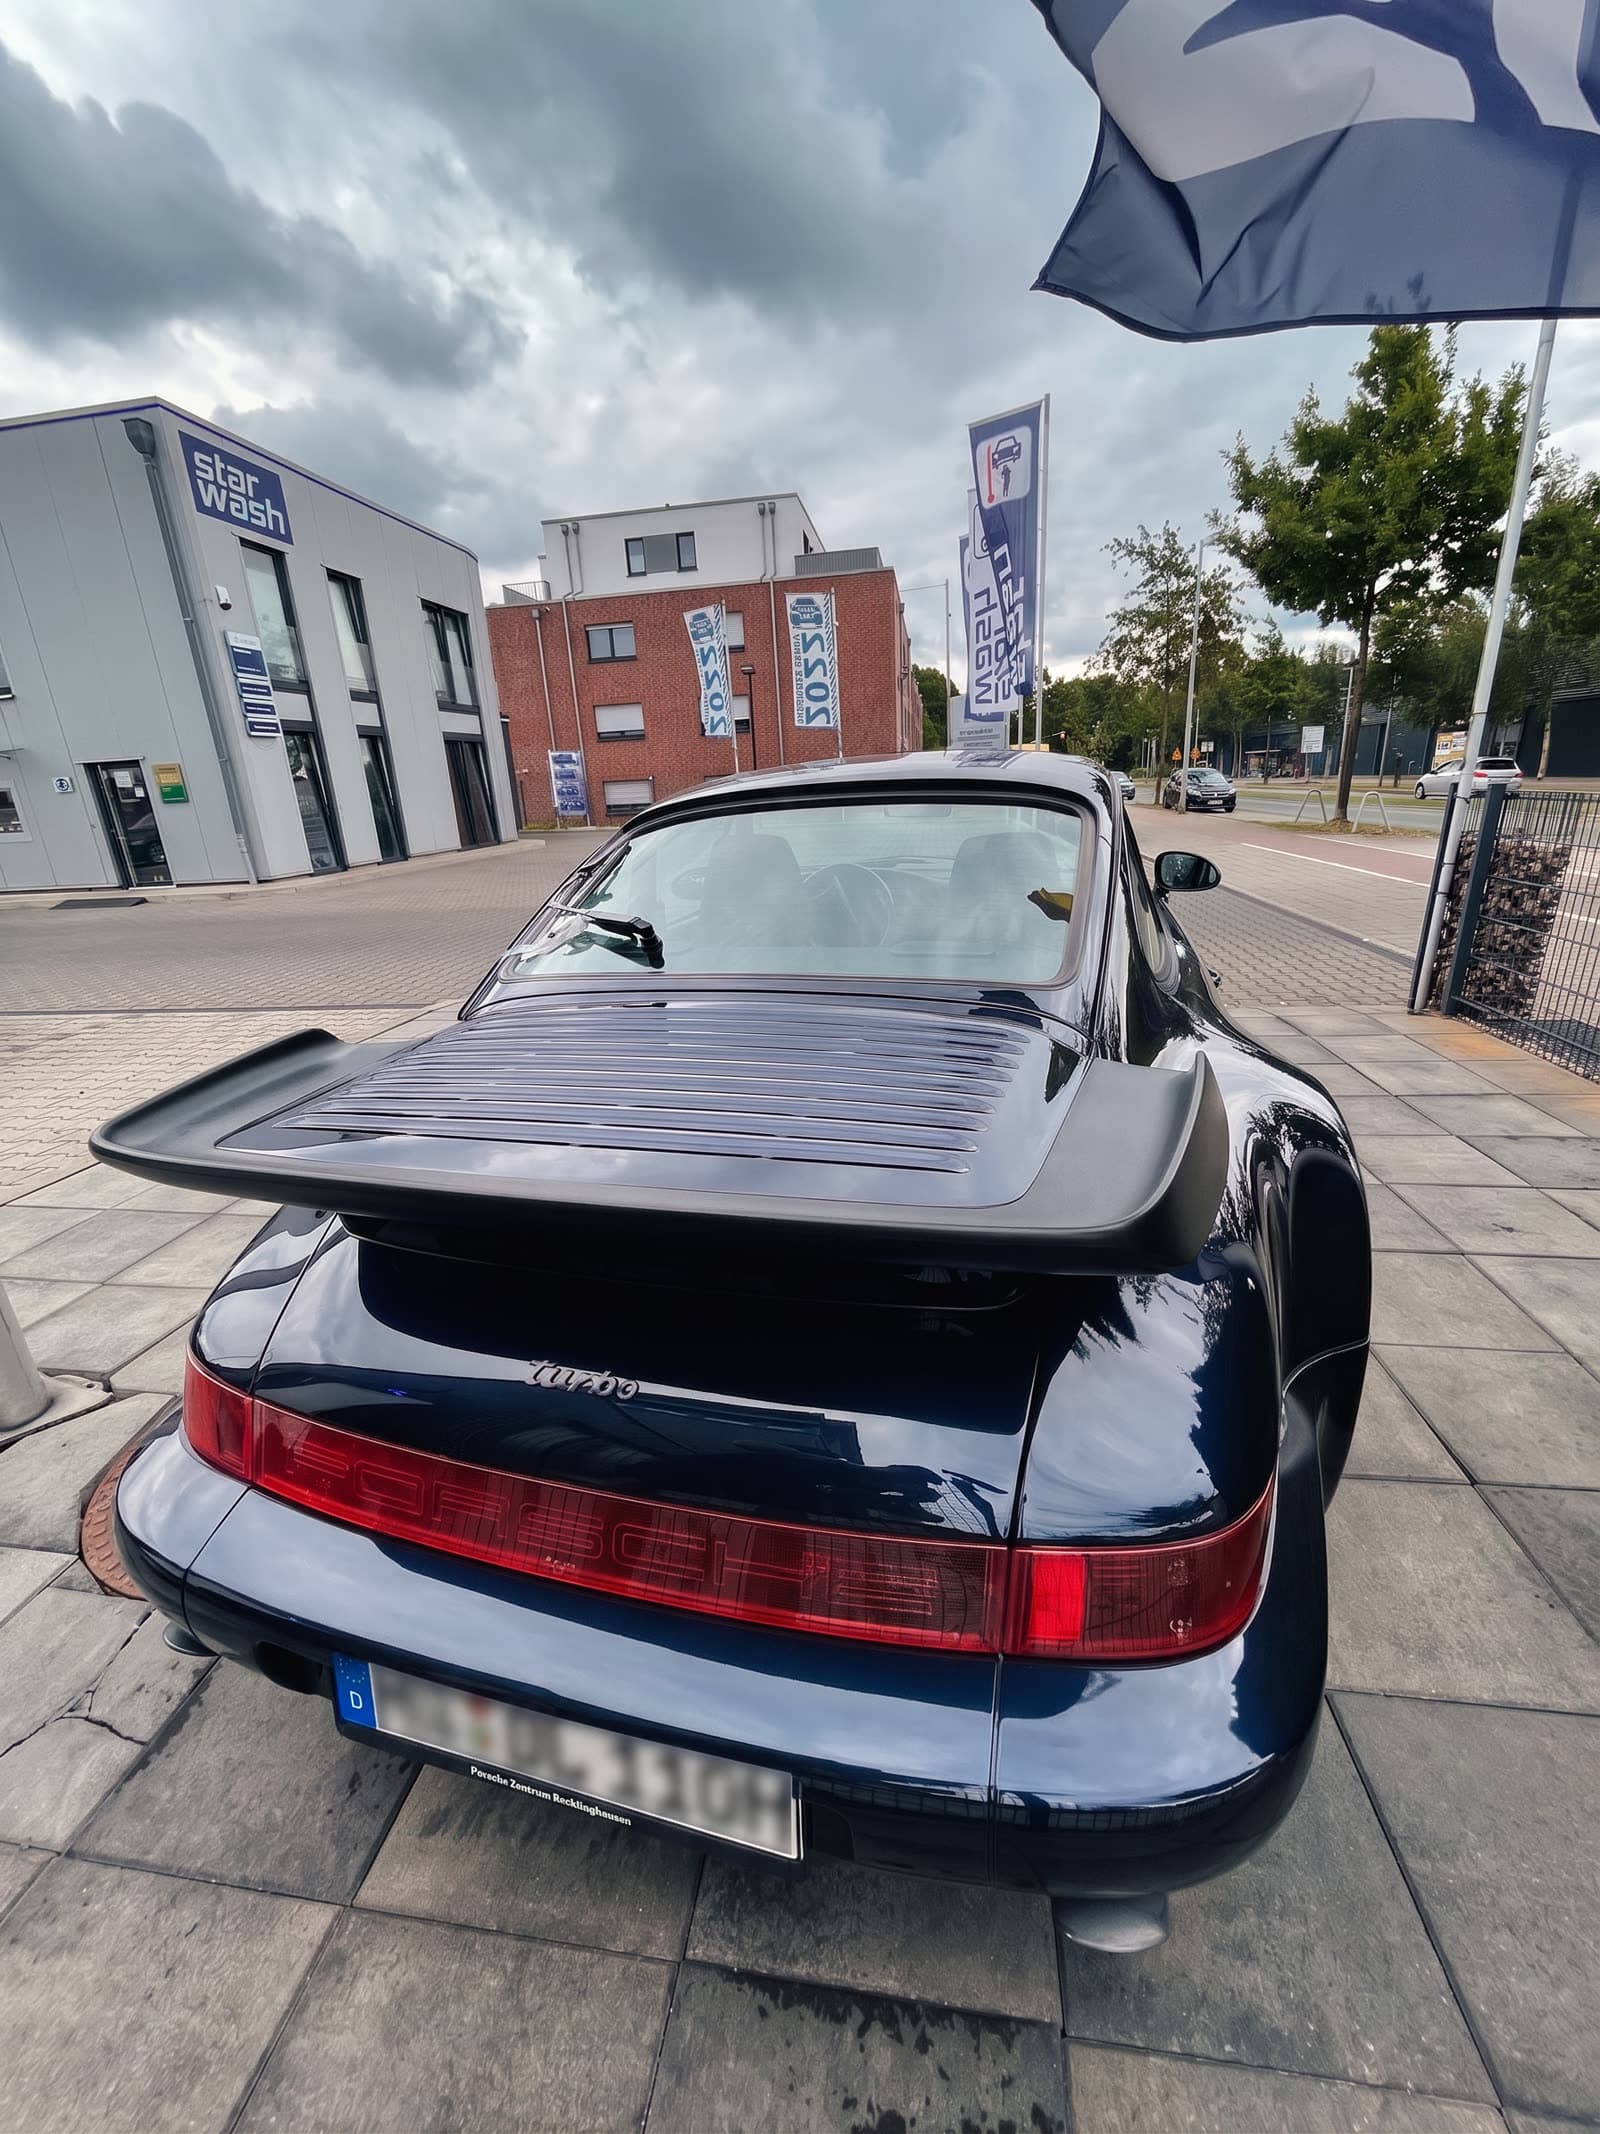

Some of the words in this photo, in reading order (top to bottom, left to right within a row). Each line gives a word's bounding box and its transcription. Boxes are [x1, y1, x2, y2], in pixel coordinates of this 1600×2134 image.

[194, 451, 259, 498] star
[197, 478, 286, 535] wash
[525, 1360, 640, 1400] turbo
[349, 1689, 363, 1710] D
[470, 1765, 509, 1786] Porsche
[510, 1778, 551, 1801] Zentrum
[552, 1792, 632, 1826] Recklinghausen
